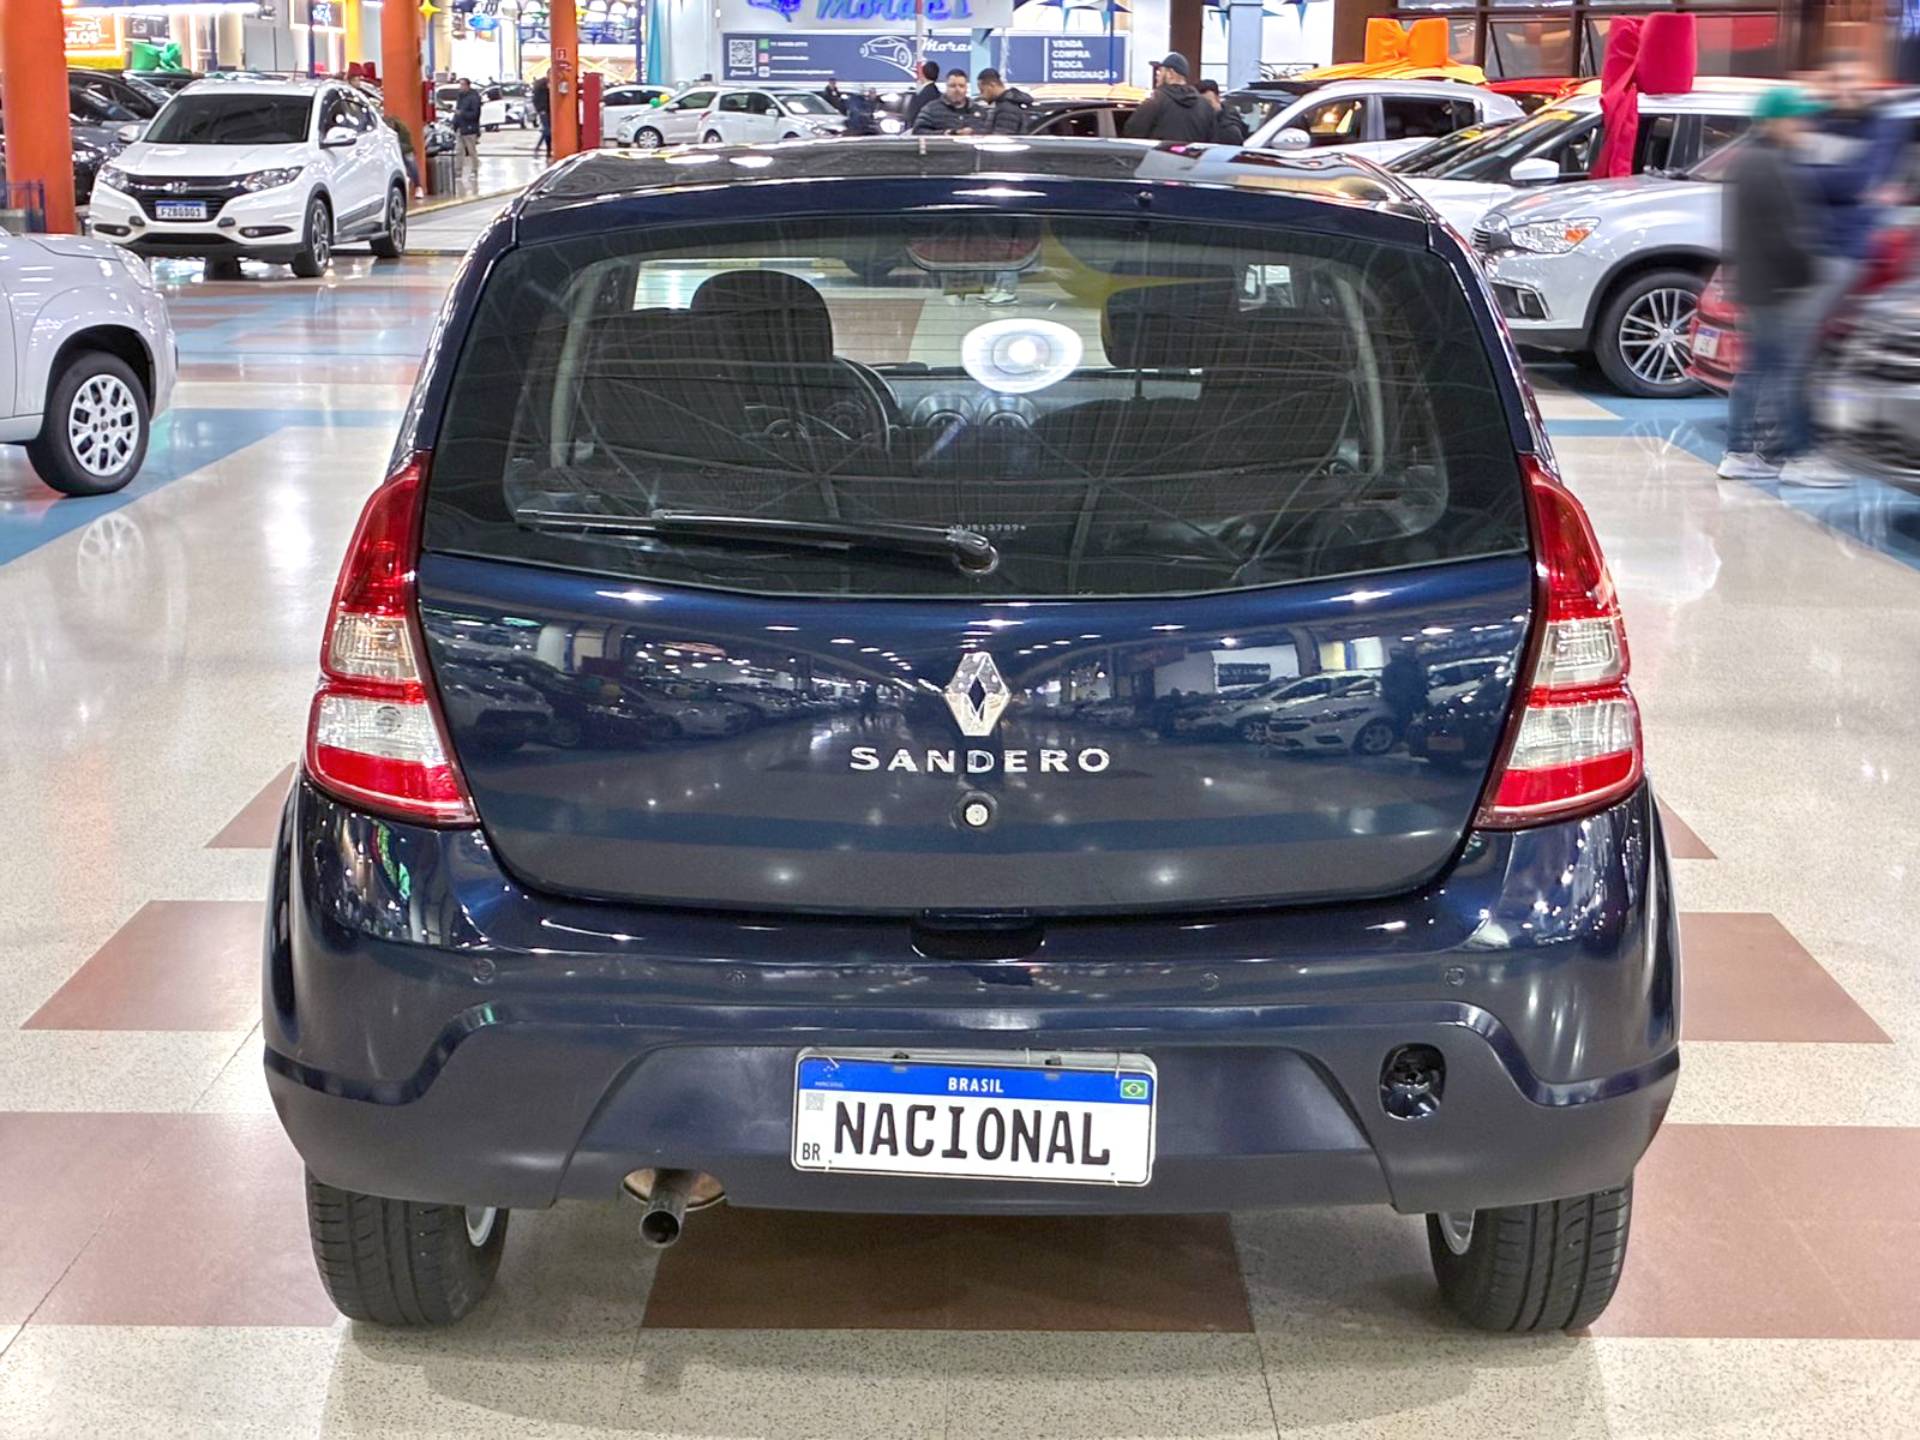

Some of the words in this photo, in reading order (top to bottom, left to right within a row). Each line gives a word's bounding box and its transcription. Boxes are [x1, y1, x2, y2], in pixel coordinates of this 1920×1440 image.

[1051, 40, 1084, 49] VENDA
[1051, 50, 1091, 59] COMPRA
[1051, 60, 1084, 69] TROCA
[850, 747, 1110, 773] SANDERO
[947, 1077, 1004, 1093] BRASIL
[834, 1101, 1110, 1166] NACIONAL
[802, 1142, 821, 1162] BR
